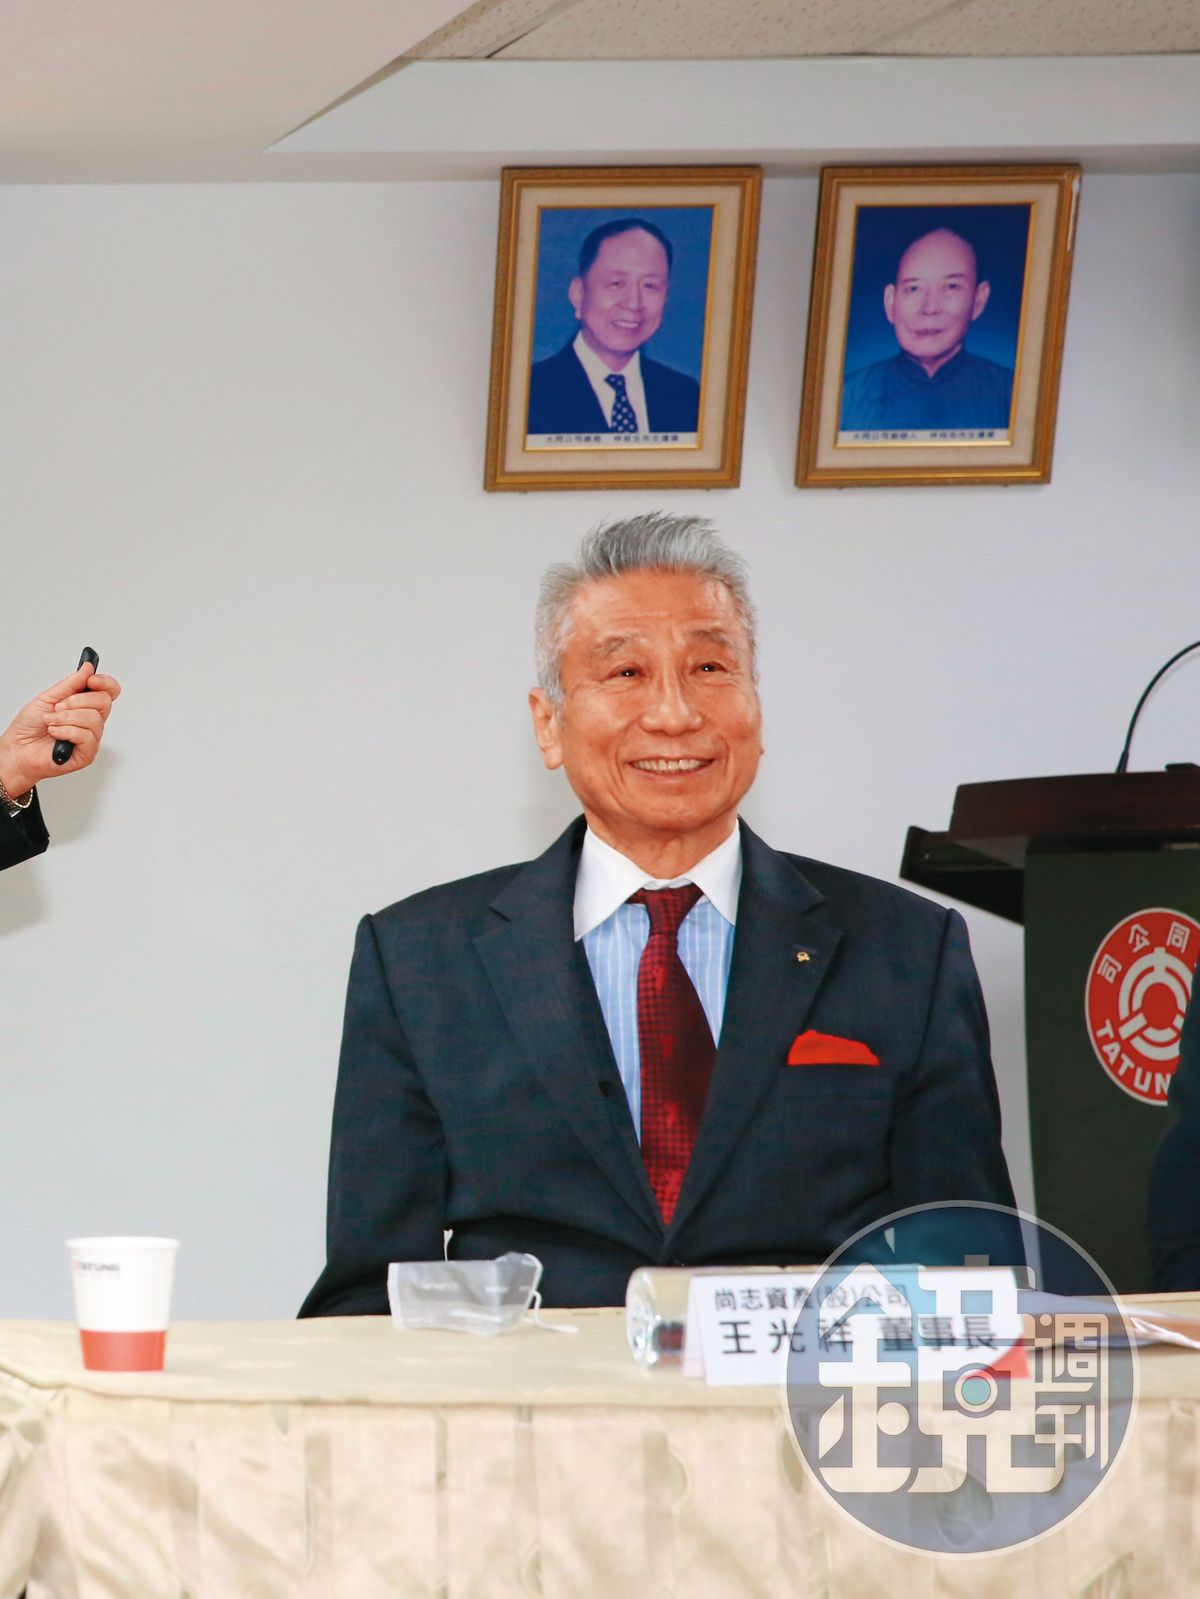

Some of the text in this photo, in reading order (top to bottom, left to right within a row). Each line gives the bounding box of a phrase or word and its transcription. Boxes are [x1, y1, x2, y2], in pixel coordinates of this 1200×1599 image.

[720, 1316, 998, 1355] 王光祥 董事長
